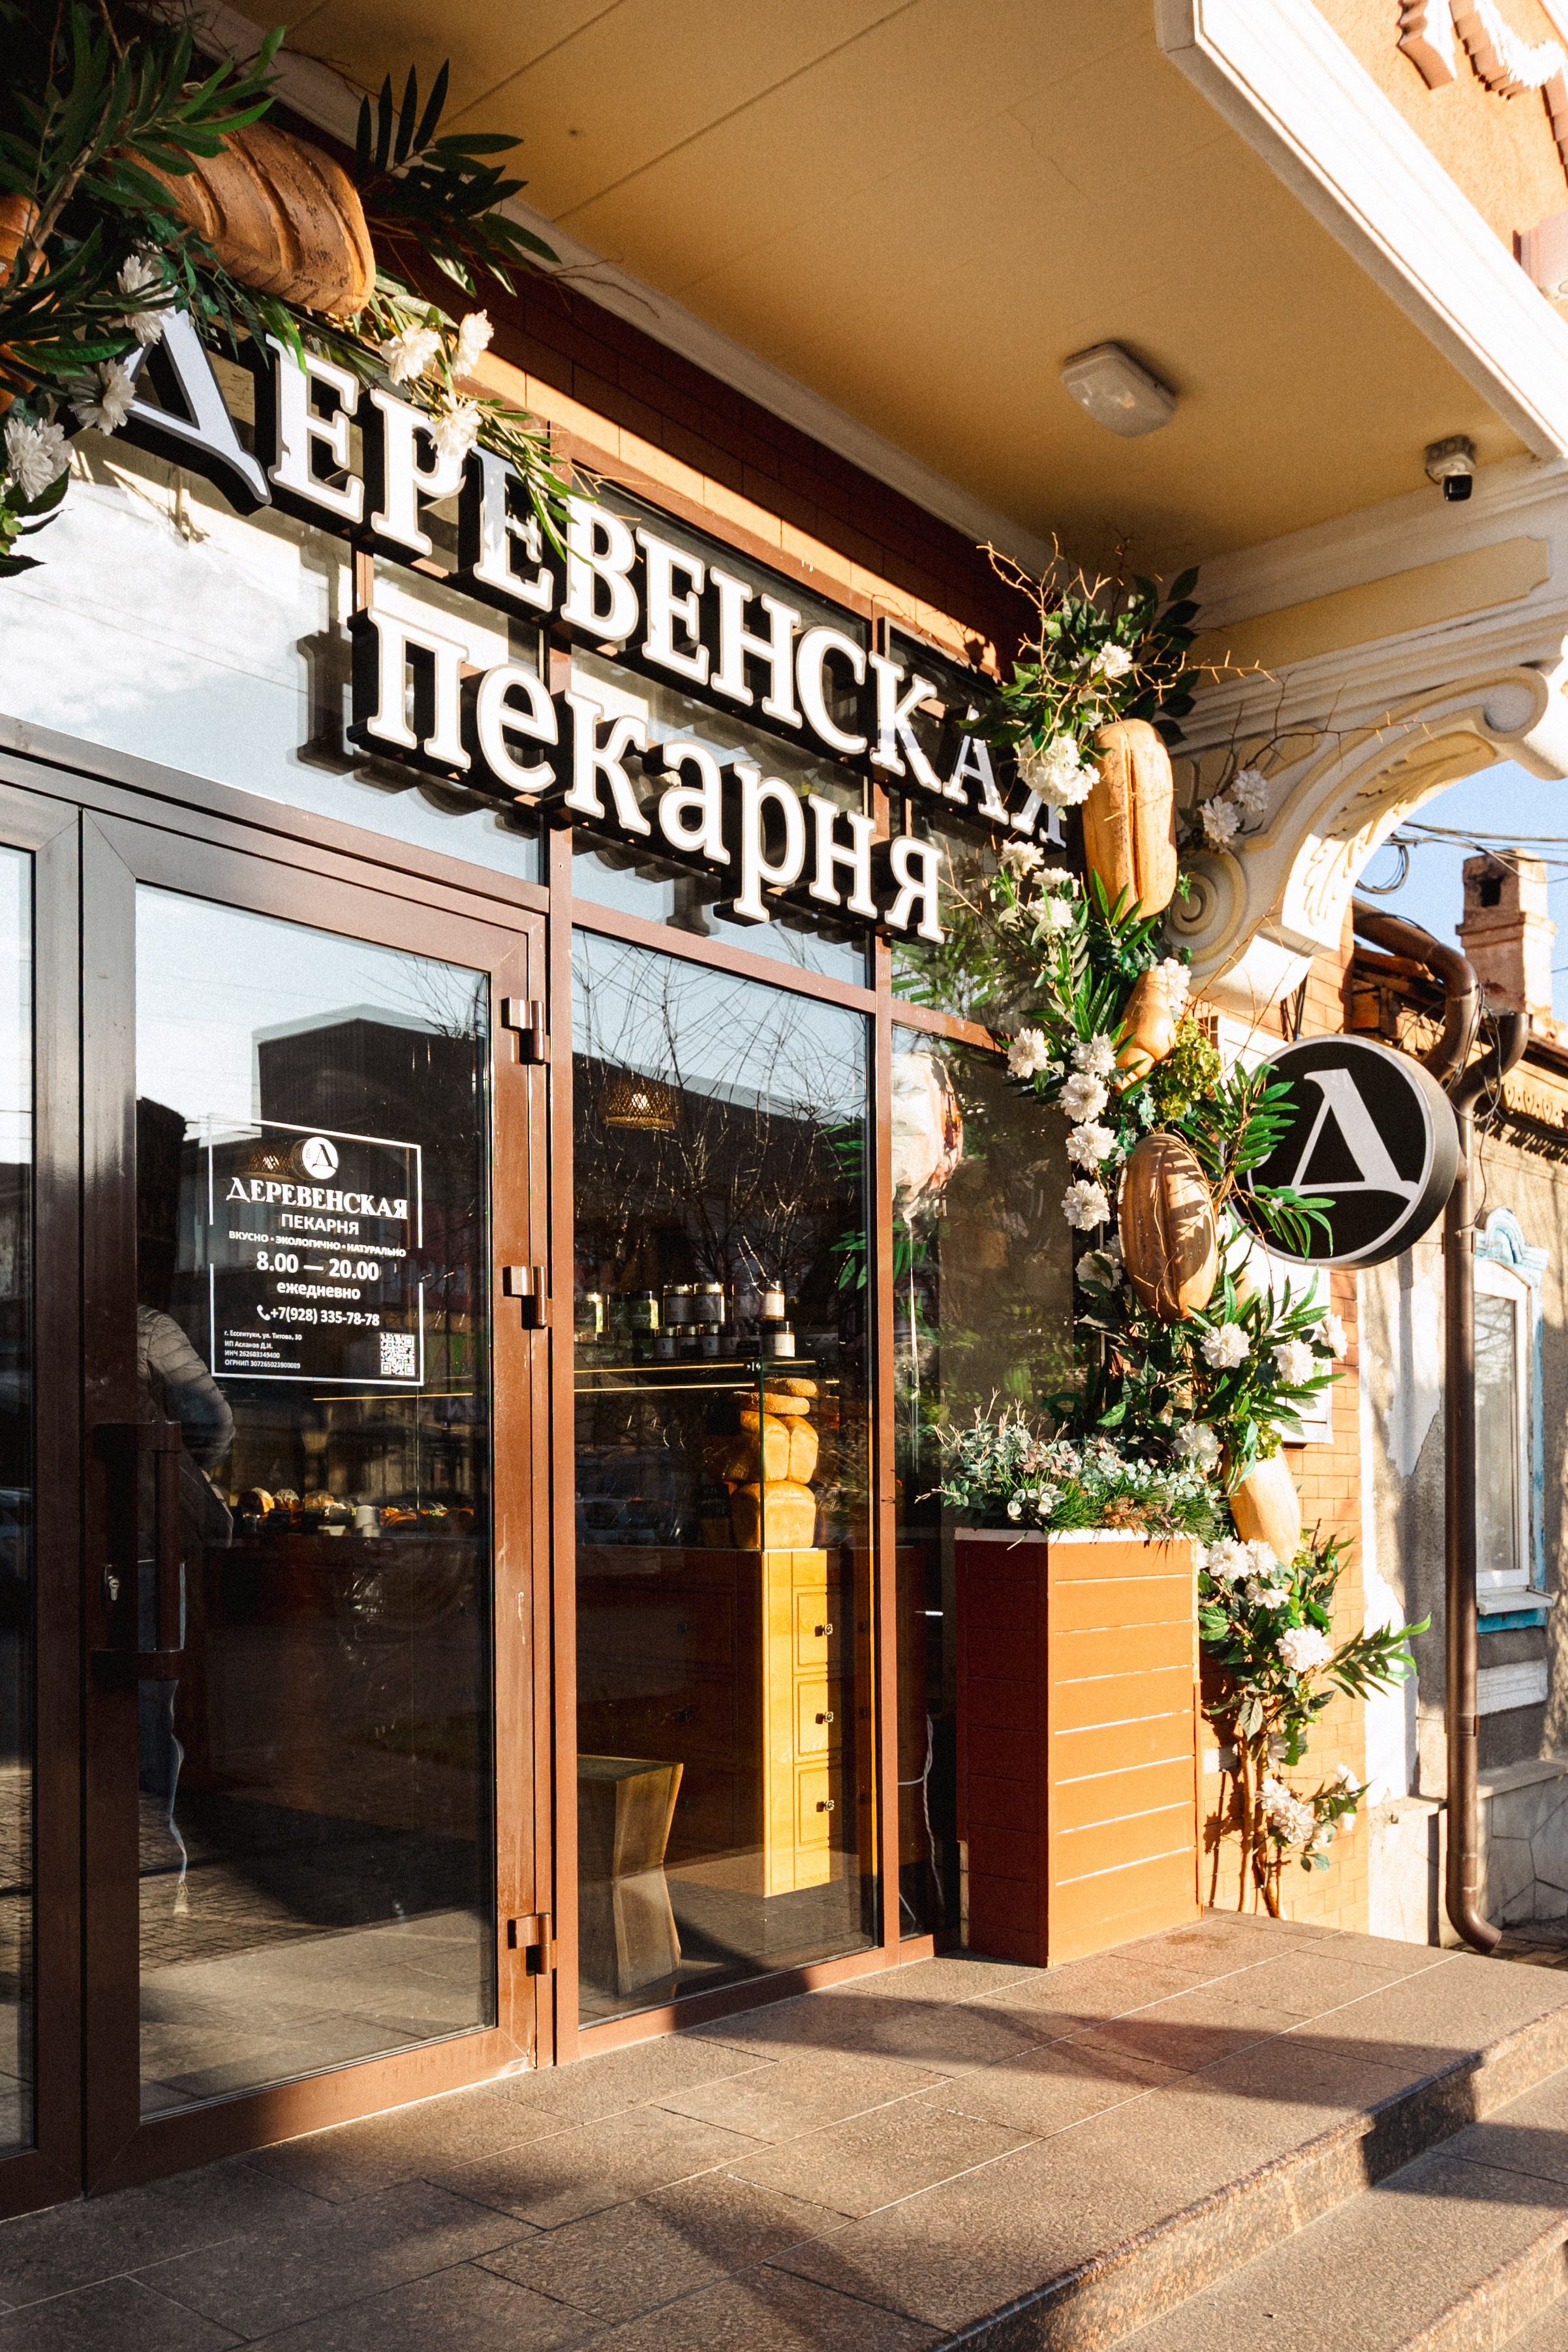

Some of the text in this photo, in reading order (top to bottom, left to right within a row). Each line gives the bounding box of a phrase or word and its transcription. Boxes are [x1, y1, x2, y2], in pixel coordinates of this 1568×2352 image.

[226, 1177, 407, 1219] ДЕРЕВЕНСКАЯ
[281, 1213, 359, 1235] ПЕКАРНЯ
[229, 1230, 407, 1258] ВКУСНО ЭКОЛОГИЧНО НАТУРАЛЬНО
[256, 1251, 299, 1273] 8.00
[329, 1258, 380, 1281] 20.00
[277, 1281, 361, 1301] ежедневно
[270, 1307, 380, 1327] +7(928) 335-78-78
[230, 1330, 261, 1338] Ессентуки,
[250, 1360, 301, 1369] 307265023900089
